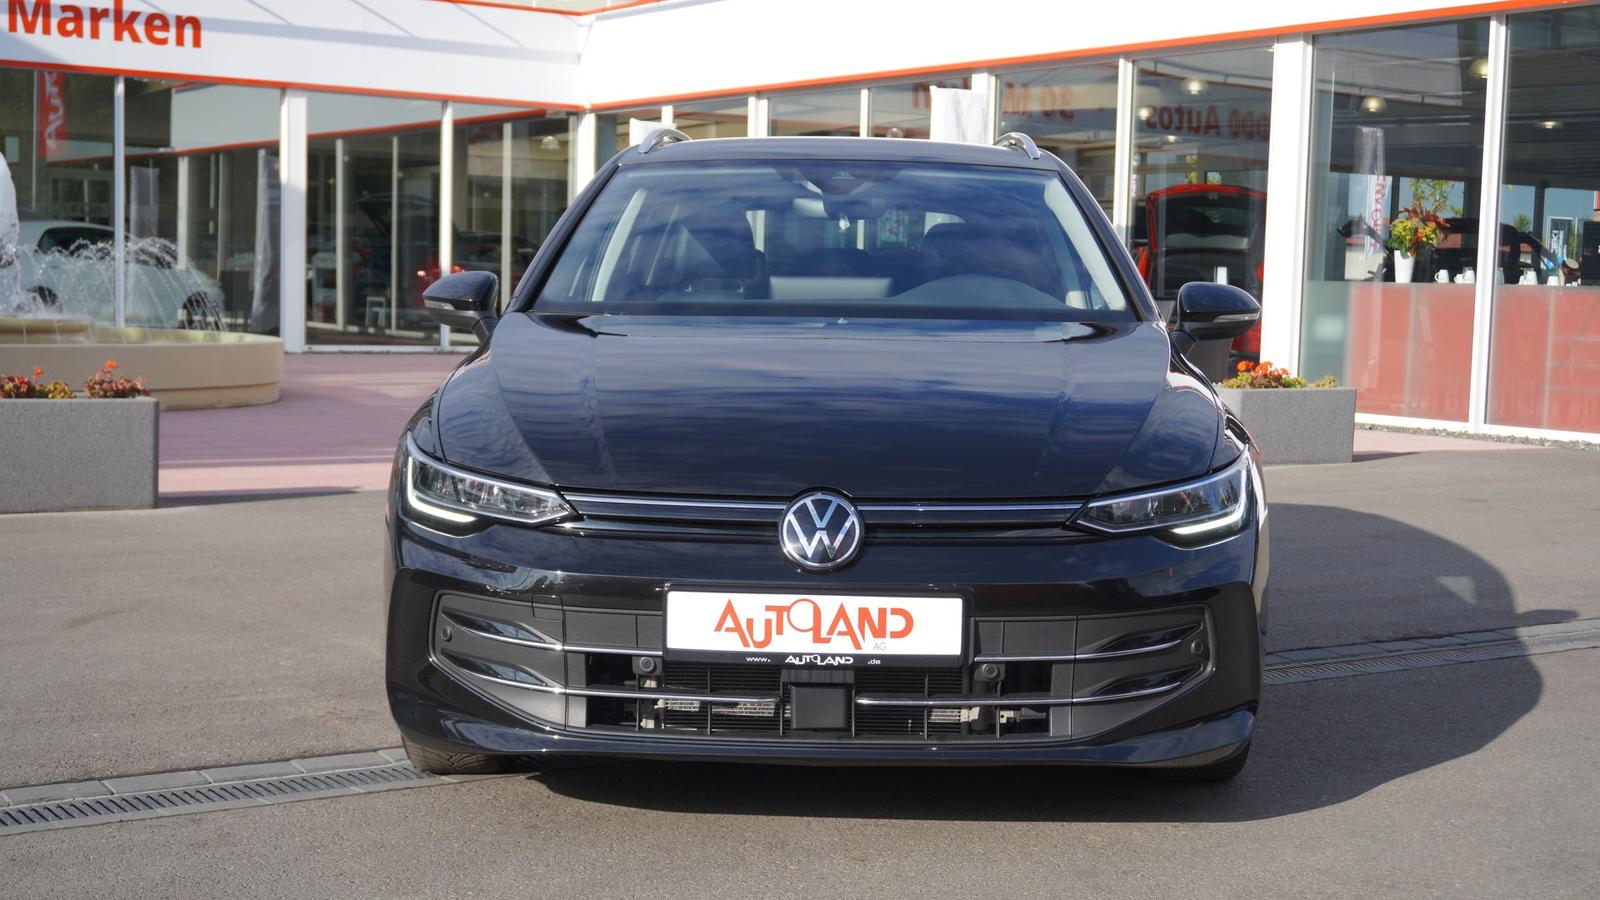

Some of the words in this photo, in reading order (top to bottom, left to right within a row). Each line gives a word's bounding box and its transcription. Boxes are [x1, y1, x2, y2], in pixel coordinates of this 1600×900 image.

[8, 0, 202, 48] Marken
[714, 598, 914, 650] AUTOLAND
[785, 654, 854, 666] AUTOLAND
[873, 642, 886, 650] AG
